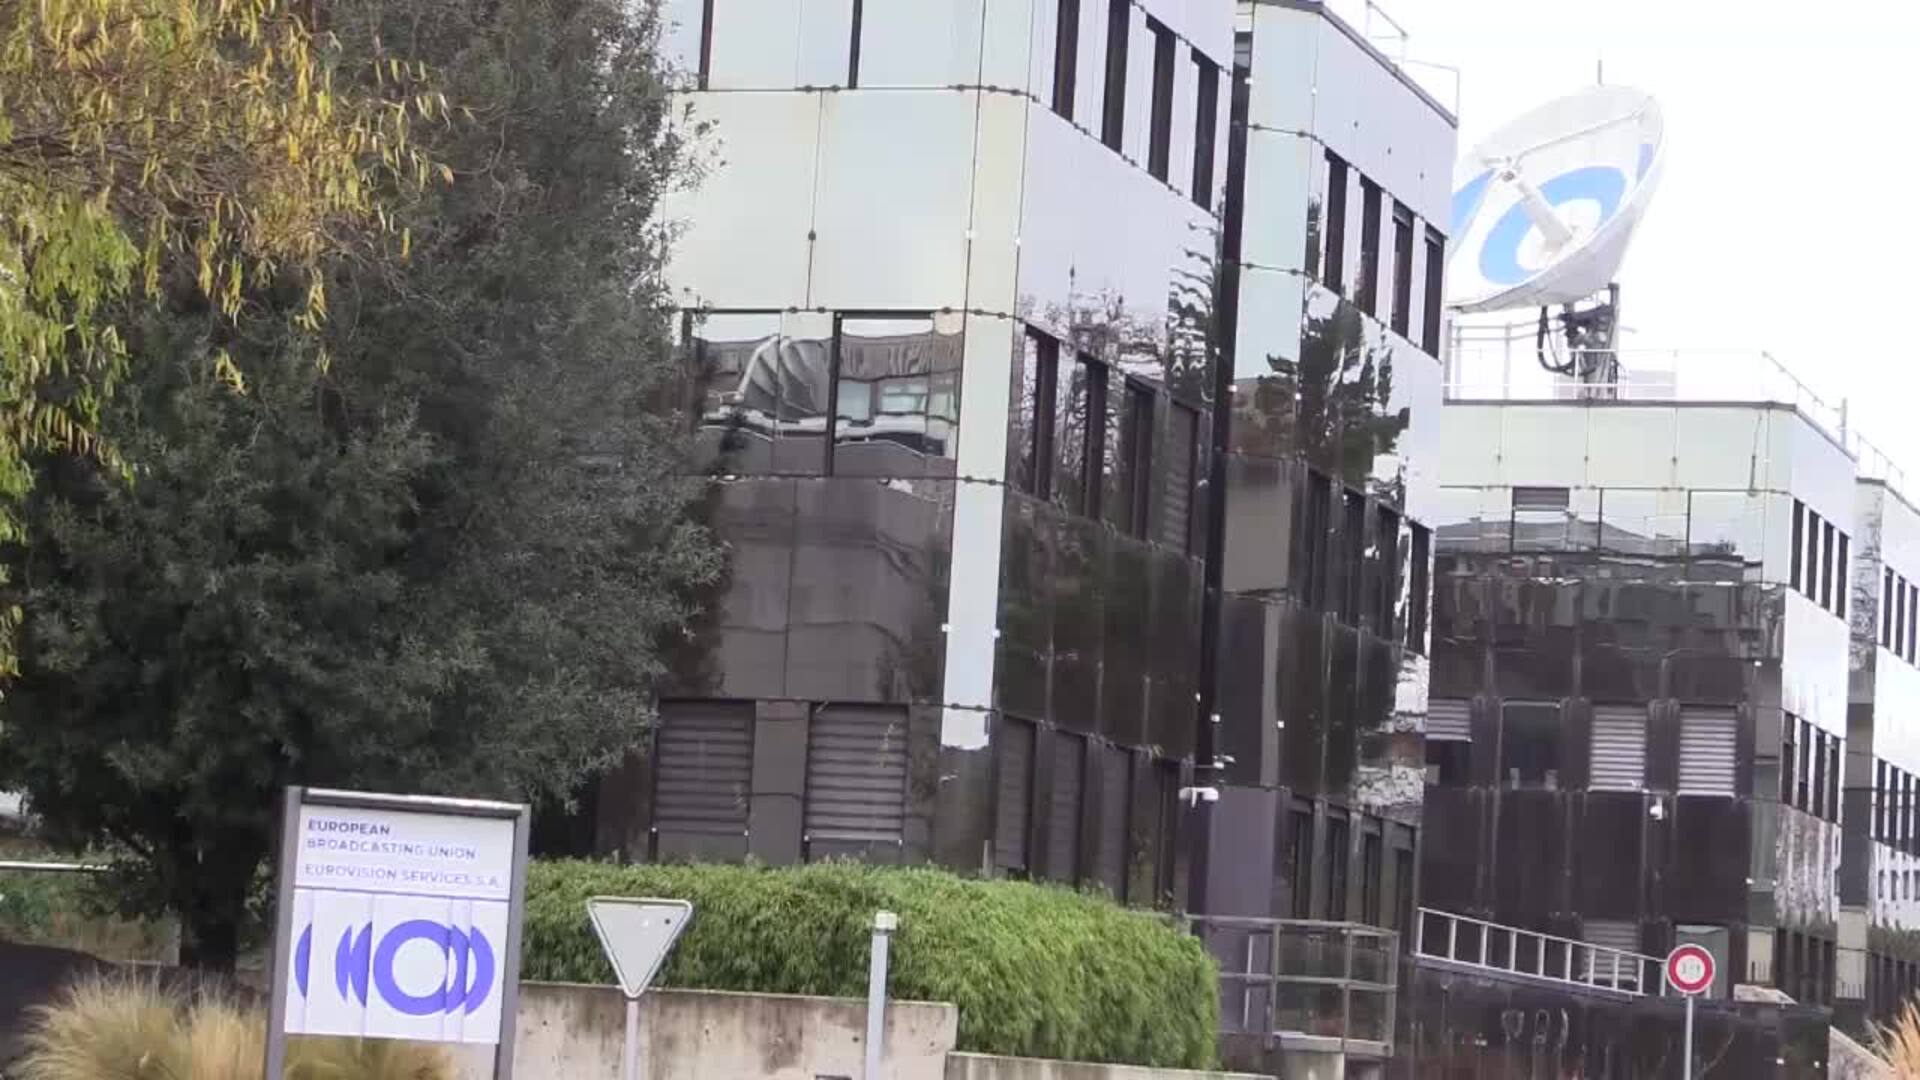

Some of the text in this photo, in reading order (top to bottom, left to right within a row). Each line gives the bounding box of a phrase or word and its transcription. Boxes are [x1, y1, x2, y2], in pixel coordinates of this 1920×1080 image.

[308, 819, 390, 835] EUROPEAN
[307, 840, 476, 860] BROADCASTING UNION
[305, 864, 397, 881] EUROVISION
[402, 869, 471, 885] SERVICES
